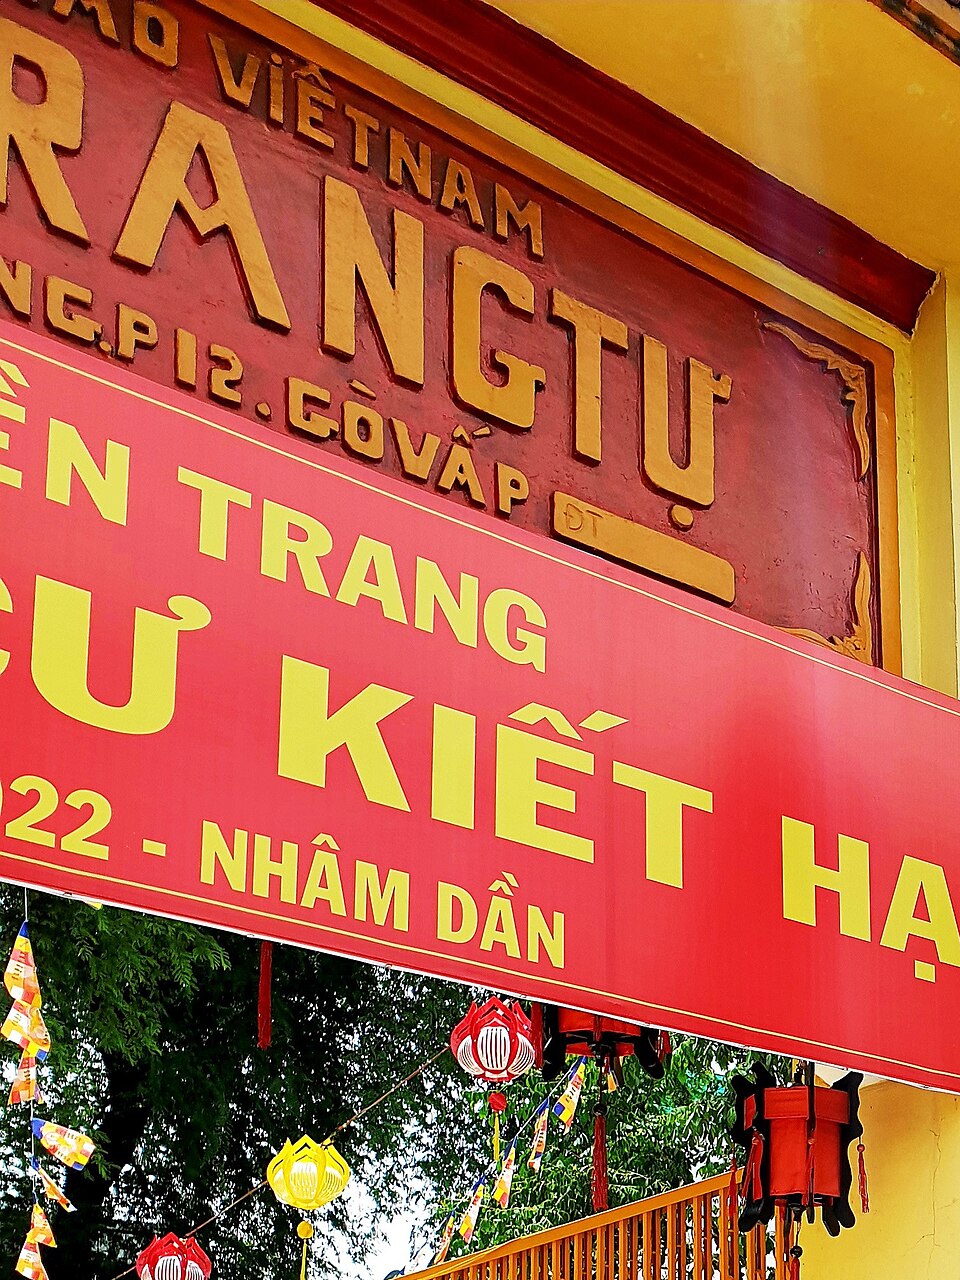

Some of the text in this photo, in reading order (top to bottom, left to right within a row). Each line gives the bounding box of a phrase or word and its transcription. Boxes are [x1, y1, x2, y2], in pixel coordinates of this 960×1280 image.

[177, 465, 548, 674] TRANG
[0, 574, 212, 735] Ư
[278, 656, 714, 888] KIẾT
[0, 774, 112, 861] 22
[200, 819, 410, 933] NHÂM
[437, 869, 566, 969] DẦN
